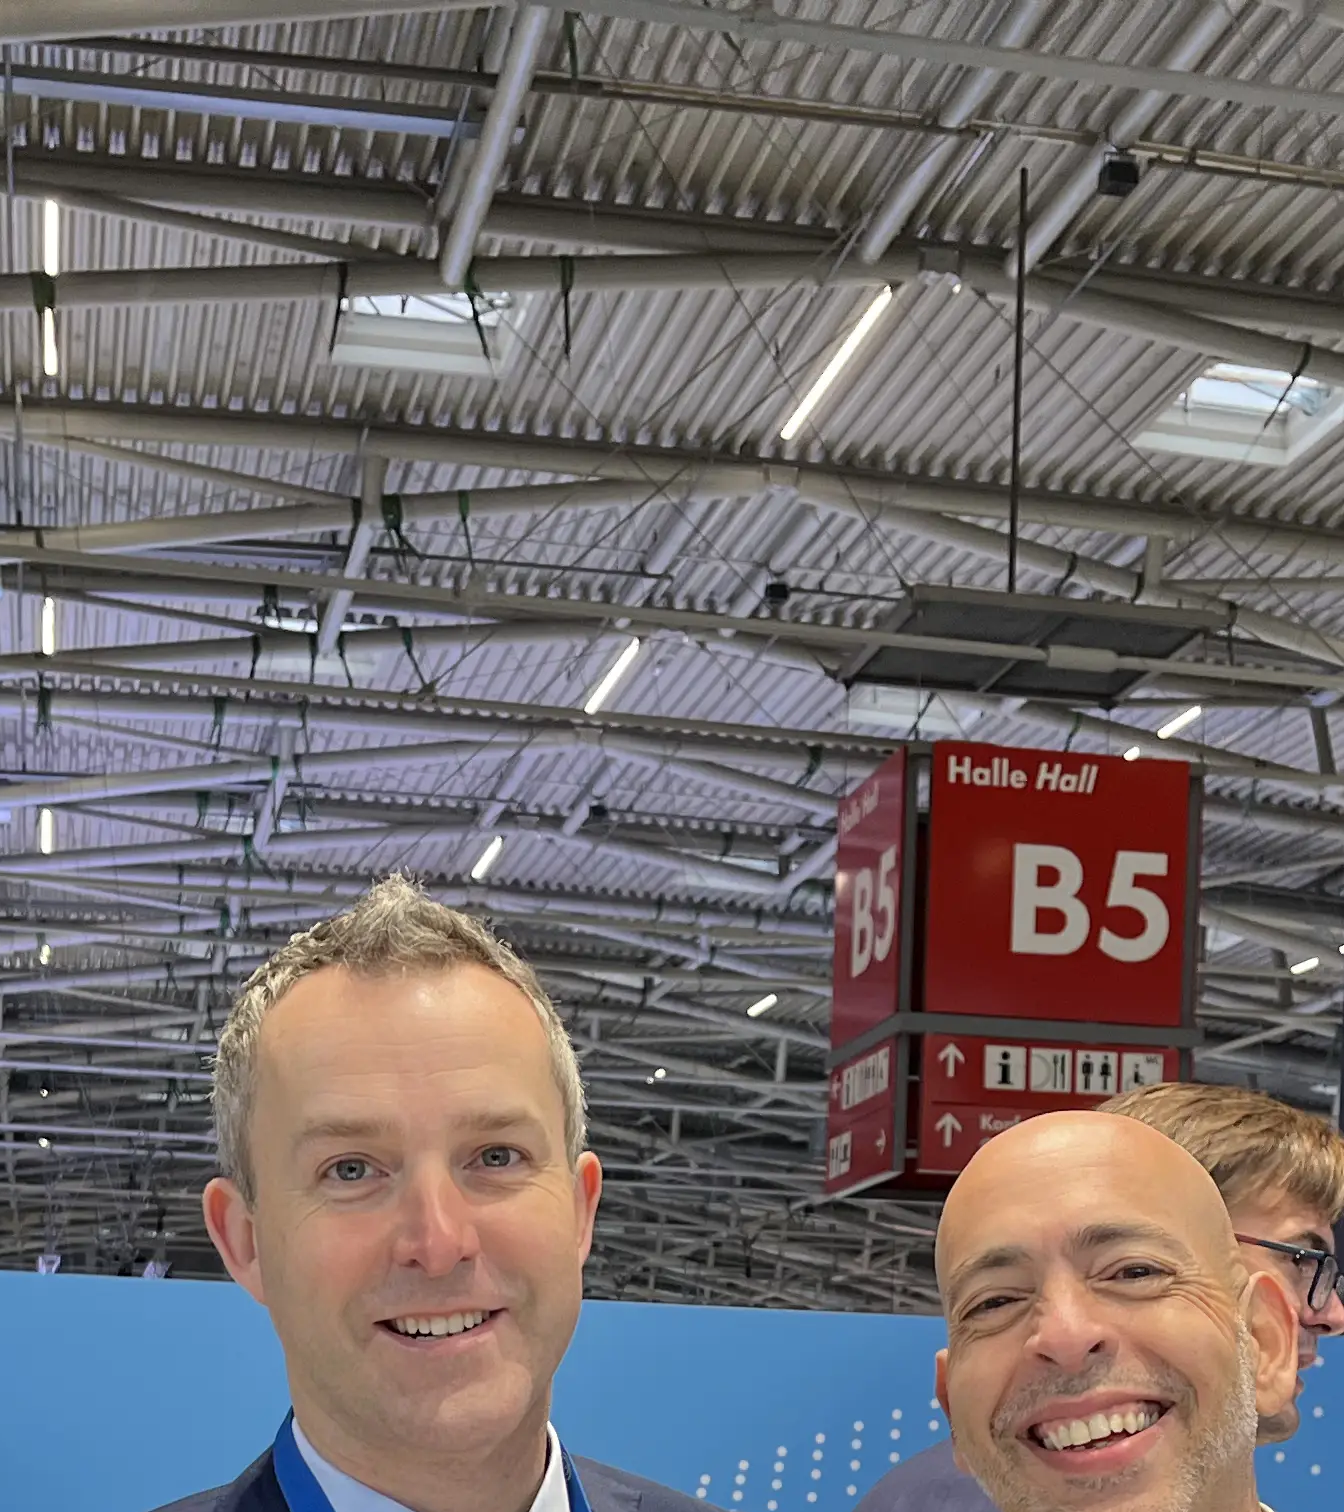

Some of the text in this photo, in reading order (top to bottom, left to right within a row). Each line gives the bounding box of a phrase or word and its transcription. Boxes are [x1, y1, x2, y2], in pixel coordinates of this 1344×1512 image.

[947, 755, 1099, 795] Halle Hall
[851, 843, 897, 978] B5
[1011, 843, 1170, 963] B5
